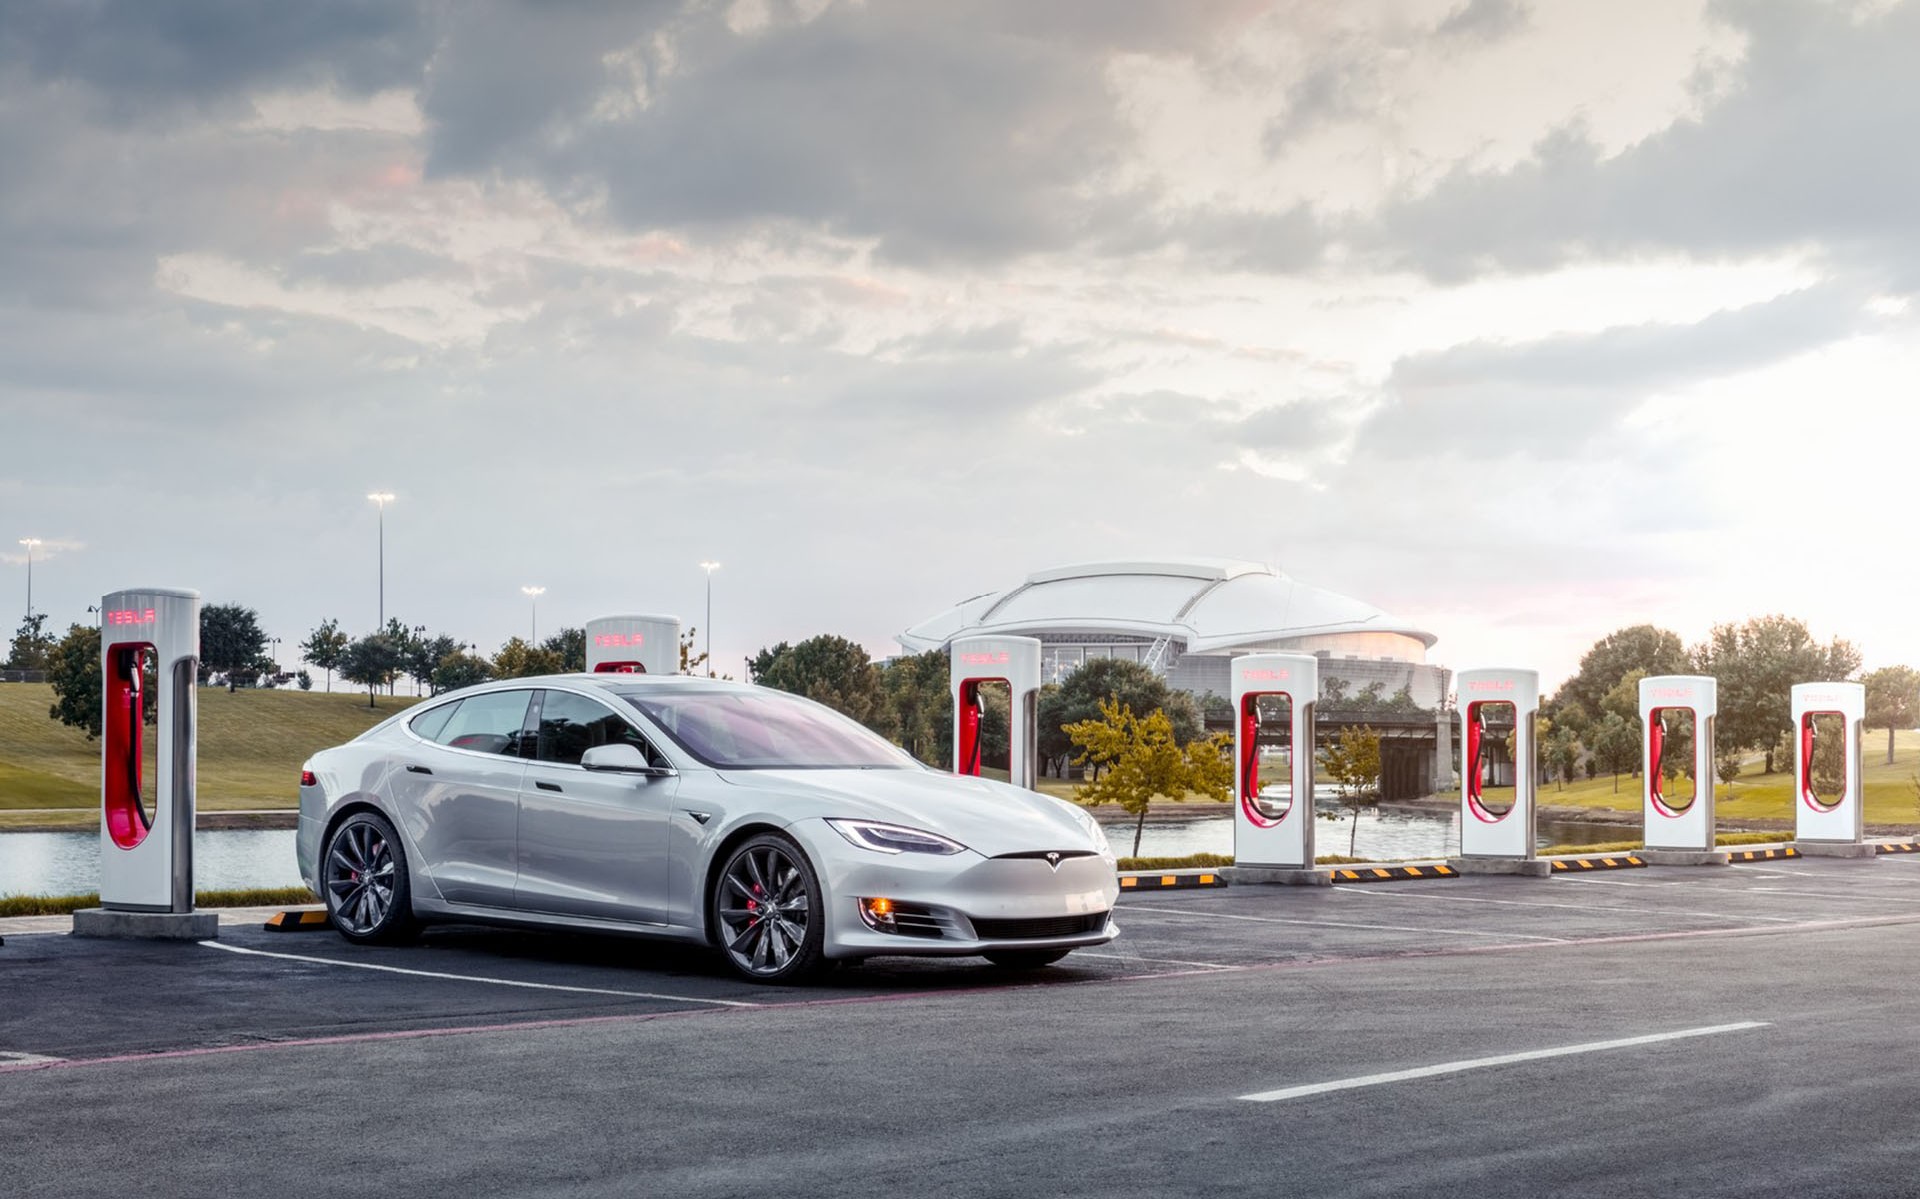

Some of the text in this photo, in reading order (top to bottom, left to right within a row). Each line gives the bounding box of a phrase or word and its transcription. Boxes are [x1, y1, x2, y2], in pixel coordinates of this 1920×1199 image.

[107, 608, 155, 625] TESLA
[594, 634, 643, 647] TESLA
[960, 652, 1008, 665] TESLA
